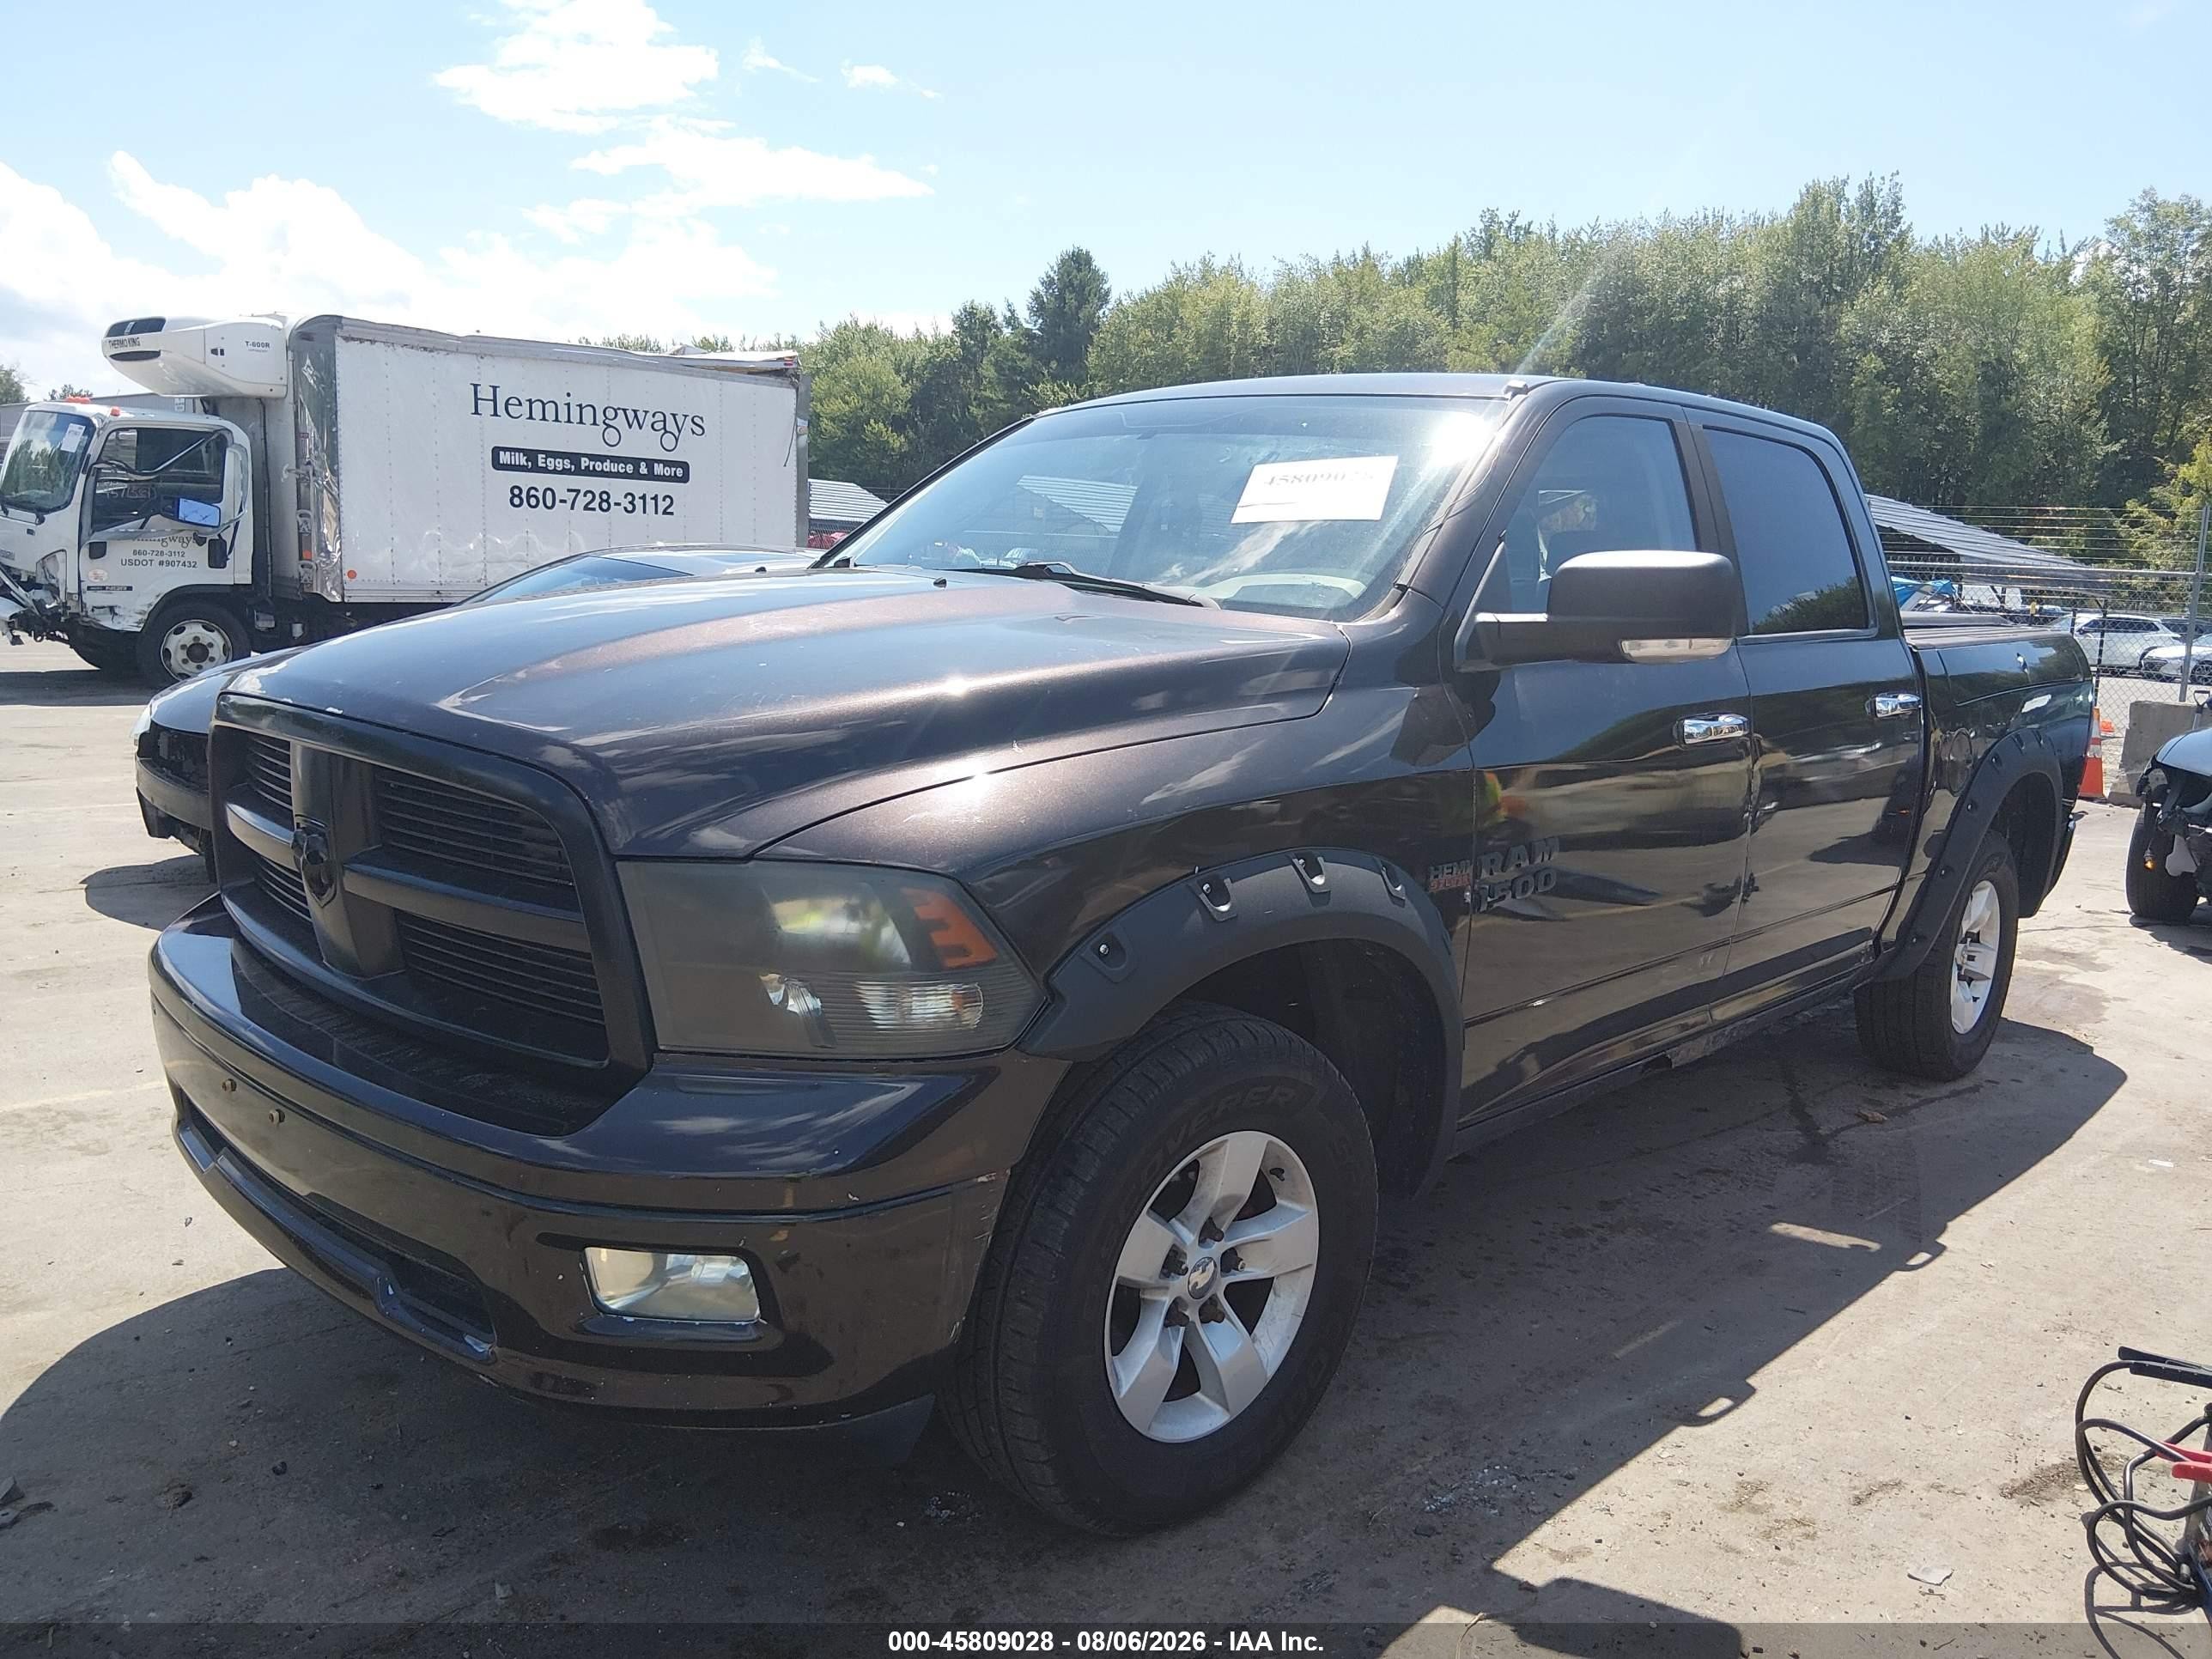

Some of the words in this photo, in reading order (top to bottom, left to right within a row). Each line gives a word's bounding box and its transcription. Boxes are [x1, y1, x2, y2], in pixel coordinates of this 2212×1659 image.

[470, 383, 705, 453] Hemingways
[499, 451, 532, 469] Milk,
[538, 453, 575, 472] Eggs,
[580, 457, 634, 474] Produce
[639, 461, 648, 475] &
[653, 463, 684, 477] More
[508, 485, 675, 515] 860-728-3112
[120, 558, 155, 567] USDOT
[158, 559, 198, 568] #907432
[132, 549, 185, 558] 860-728-3112
[1430, 860, 1471, 880] HEMI
[1476, 837, 1560, 879] RAM
[1475, 866, 1557, 913] 1500
